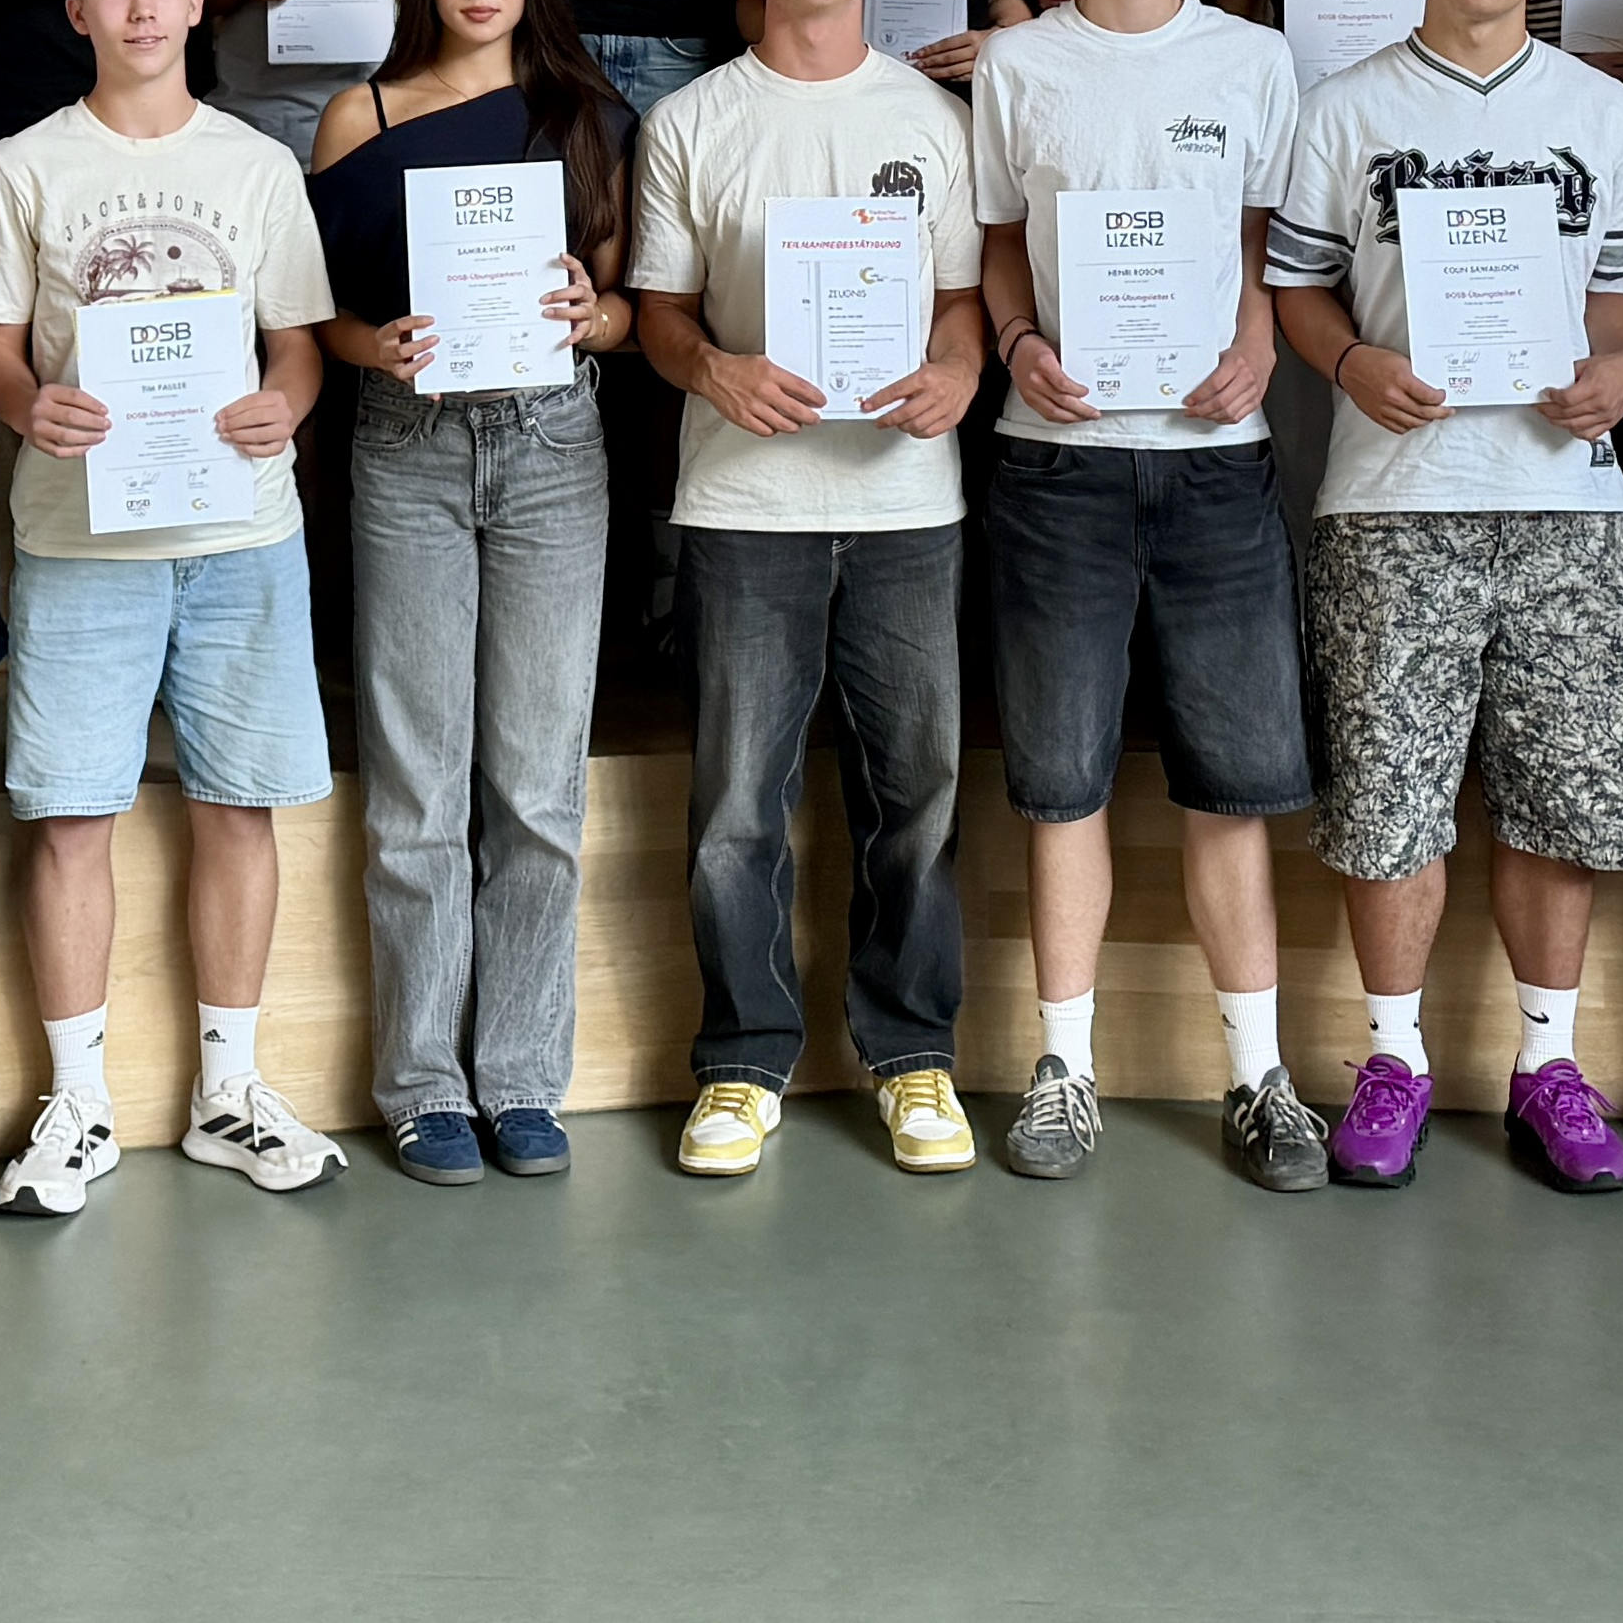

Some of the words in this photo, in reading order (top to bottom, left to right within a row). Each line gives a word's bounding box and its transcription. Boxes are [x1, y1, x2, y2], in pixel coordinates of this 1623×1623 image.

[454, 186, 514, 207] DOSB
[456, 208, 514, 226] LIZENZ
[1106, 211, 1165, 230] DOSB
[1446, 208, 1507, 227] DOSB
[1106, 232, 1165, 248] LIZENZ
[1448, 227, 1508, 245] LIZENZ
[129, 321, 193, 345] DOSB
[131, 343, 193, 364] LIZENZ
